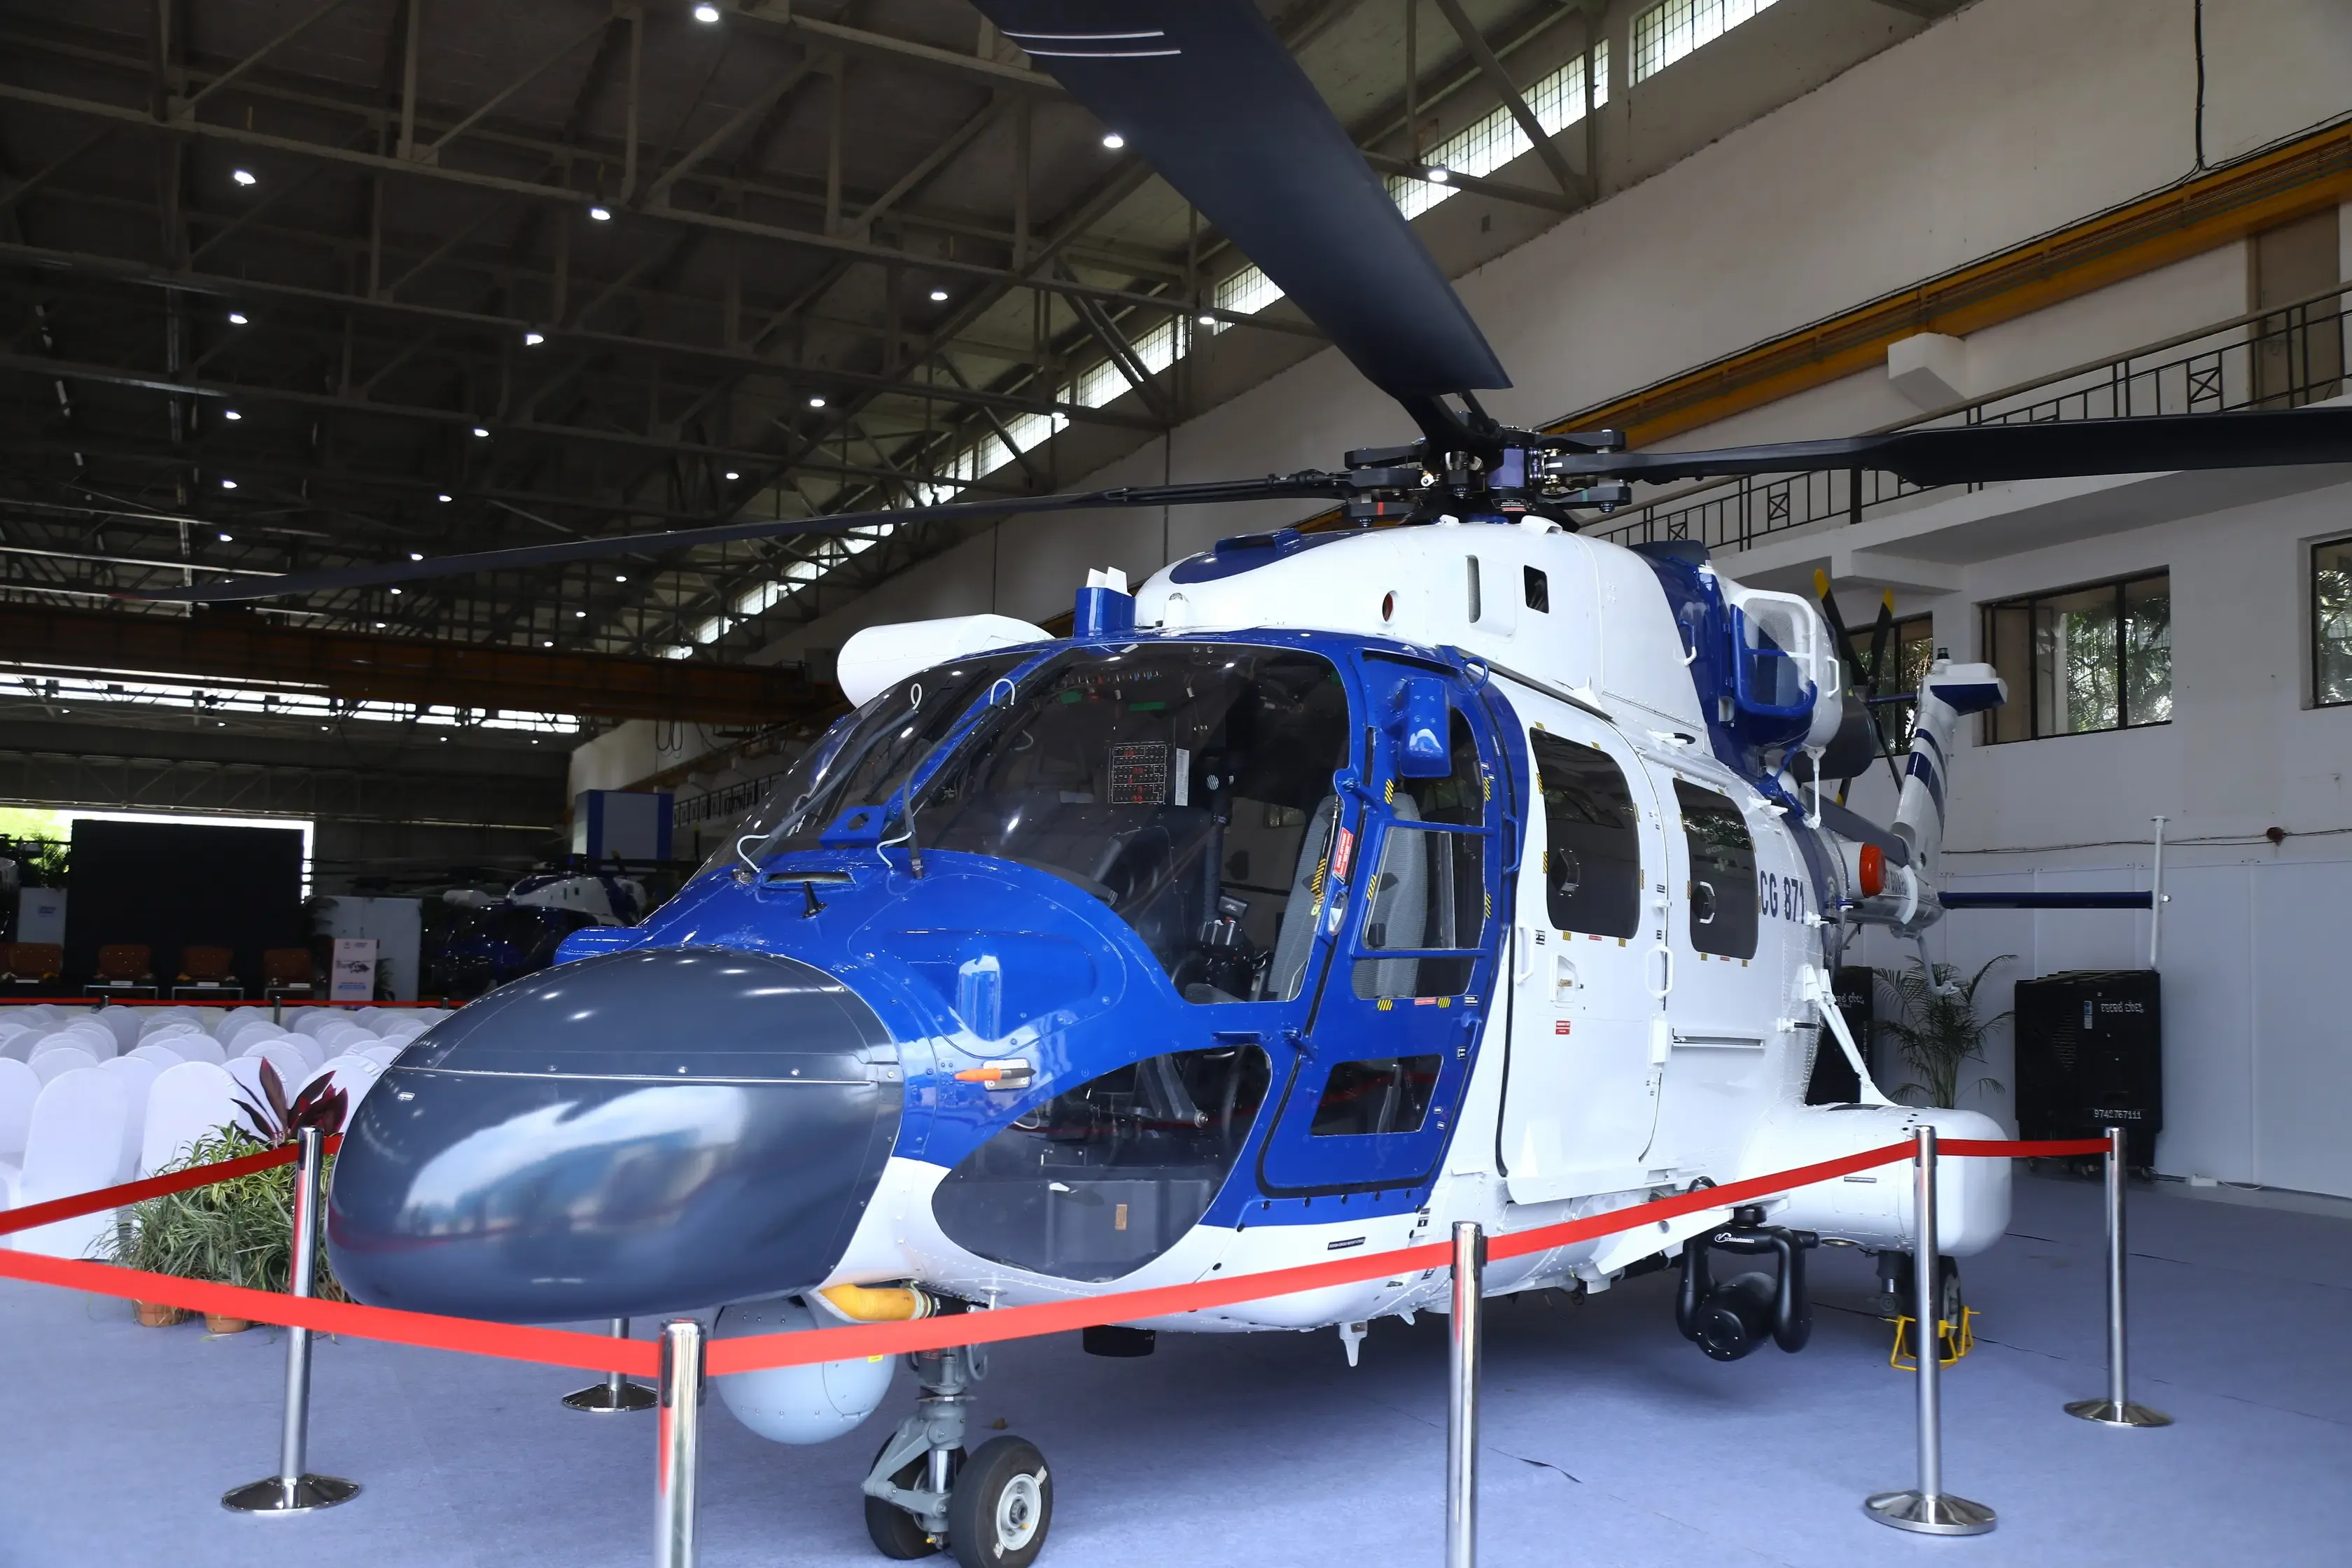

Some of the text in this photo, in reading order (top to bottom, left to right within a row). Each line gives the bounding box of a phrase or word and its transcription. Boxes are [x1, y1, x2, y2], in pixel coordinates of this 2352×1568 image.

[1705, 845, 1724, 855] BOX
[1760, 870, 1805, 925] CG 871
[2094, 1109, 2142, 1119] 9742767111
